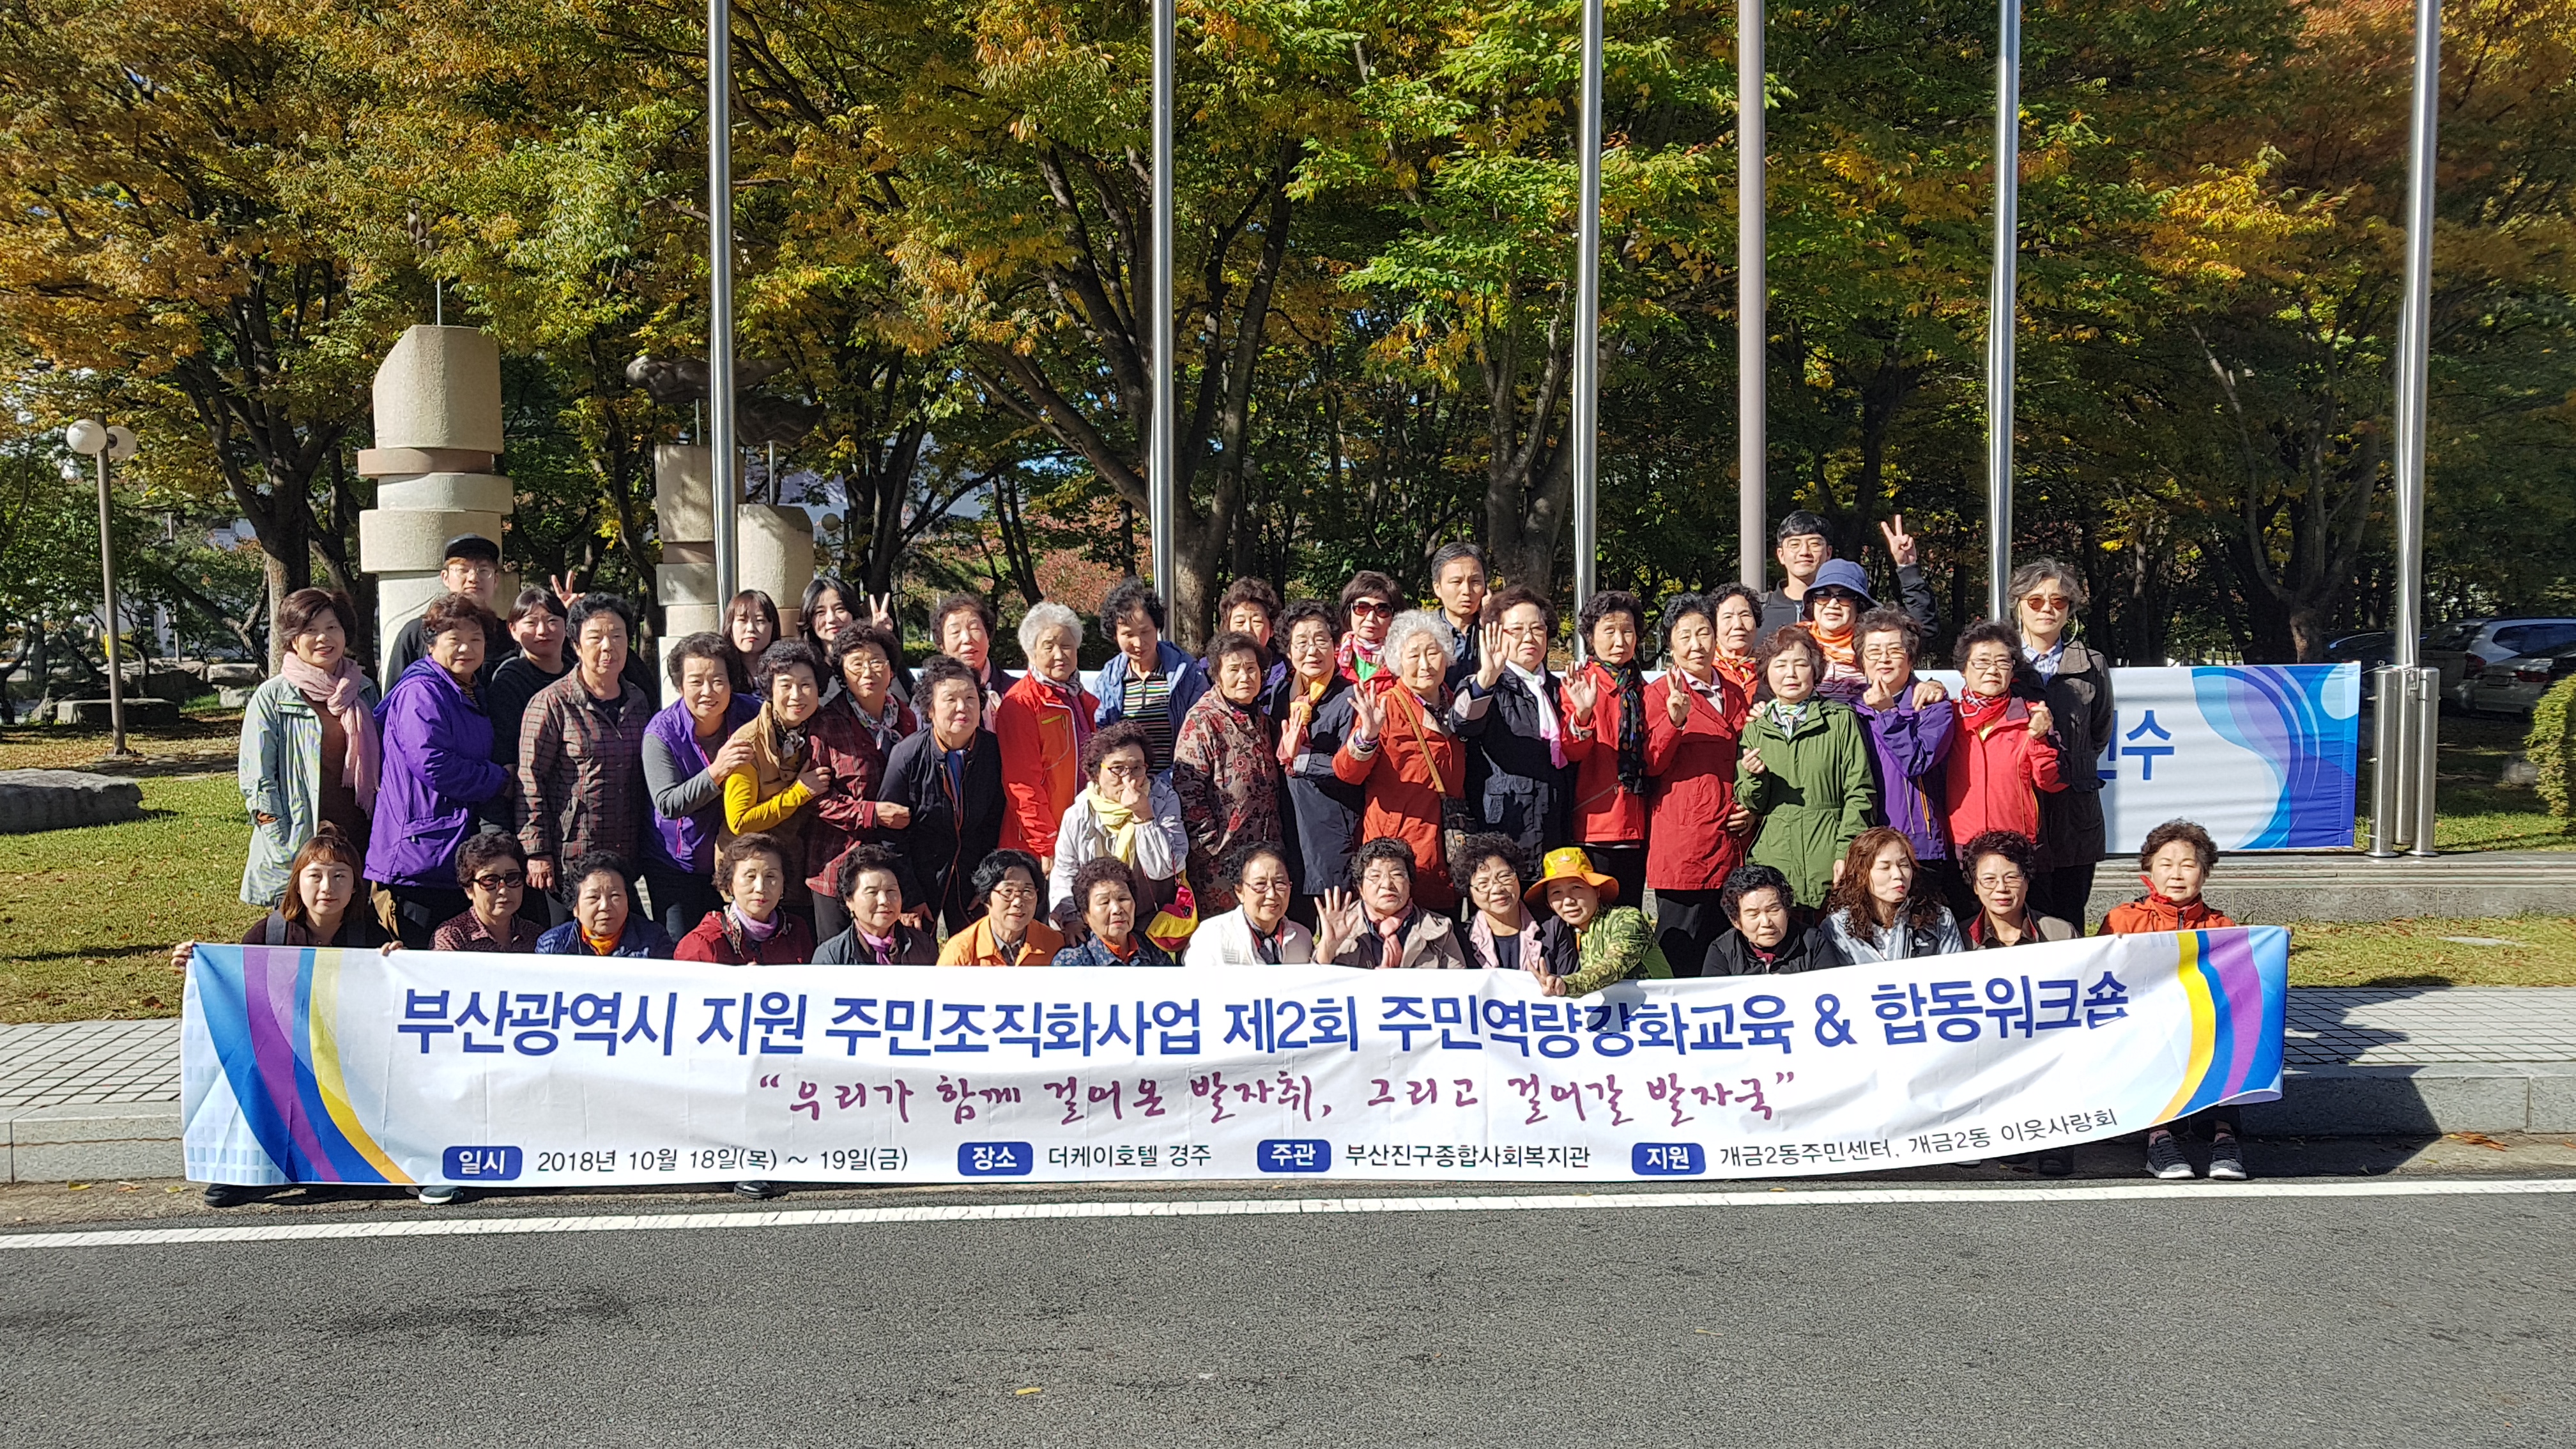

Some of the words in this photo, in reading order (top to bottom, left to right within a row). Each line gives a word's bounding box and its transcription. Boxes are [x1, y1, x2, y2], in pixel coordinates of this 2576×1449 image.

[399, 990, 677, 1055] 부산광역시
[698, 993, 807, 1055] 지원
[826, 999, 1200, 1057] 주민조직화사업
[1224, 997, 1358, 1053] 제2회
[1379, 995, 1793, 1058] 주민역량강화교육
[1815, 995, 1856, 1046] &
[1873, 971, 2129, 1045] 합동워크숍
[937, 1076, 1020, 1124] 함께
[1044, 1077, 1165, 1124] 걸어온
[1190, 1071, 1331, 1123] 발자취,
[1368, 1078, 1478, 1107] 그리고
[1508, 1074, 1633, 1125] 걸어갈
[972, 1146, 1018, 1170] 장소
[1049, 1145, 1157, 1167] 더케이호텔
[1170, 1144, 1210, 1167] 경주
[1271, 1143, 1317, 1167] 주관
[1345, 1144, 1591, 1168] 부산진구종합사회복지관
[1646, 1146, 1690, 1170] 지원
[1720, 1140, 1900, 1168] 개금2동주민센터,
[1908, 1127, 1990, 1154] 개금2동
[2001, 1108, 2117, 1142] 이웃사랑회
[459, 1150, 505, 1175] 일시
[537, 1151, 617, 1172] 2018년
[629, 1149, 677, 1171] 10월
[691, 1148, 776, 1172] 18일(목)
[820, 1147, 907, 1172] 19일(금)
